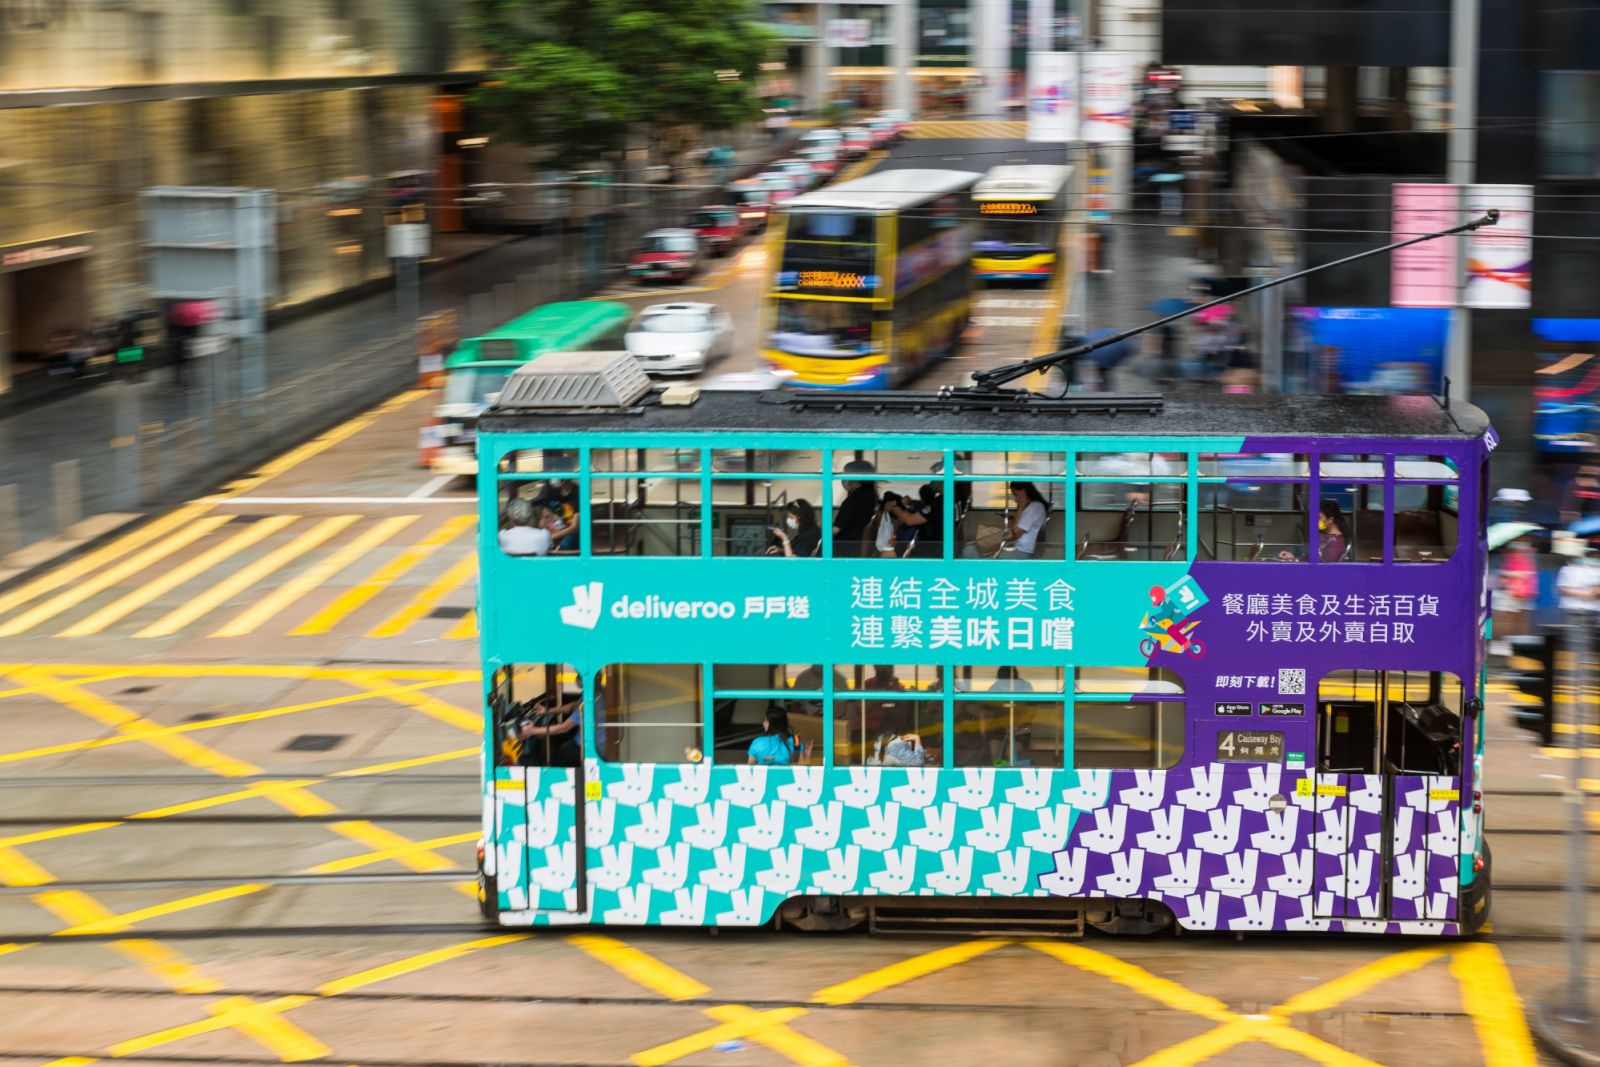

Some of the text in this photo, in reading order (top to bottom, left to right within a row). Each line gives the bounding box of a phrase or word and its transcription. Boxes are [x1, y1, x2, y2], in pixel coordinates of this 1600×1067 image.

[850, 576, 1077, 612] 連結全城美食
[1222, 593, 1440, 617] 餐廳美食及生活百貨
[611, 594, 735, 619] deliveroo
[850, 614, 1076, 650] 連繫美味日嚐
[1246, 620, 1415, 644] 外賣及外賣自取
[1272, 707, 1290, 715] Google
[1218, 731, 1236, 757] 4
[1237, 734, 1282, 745] Causeway Bay
